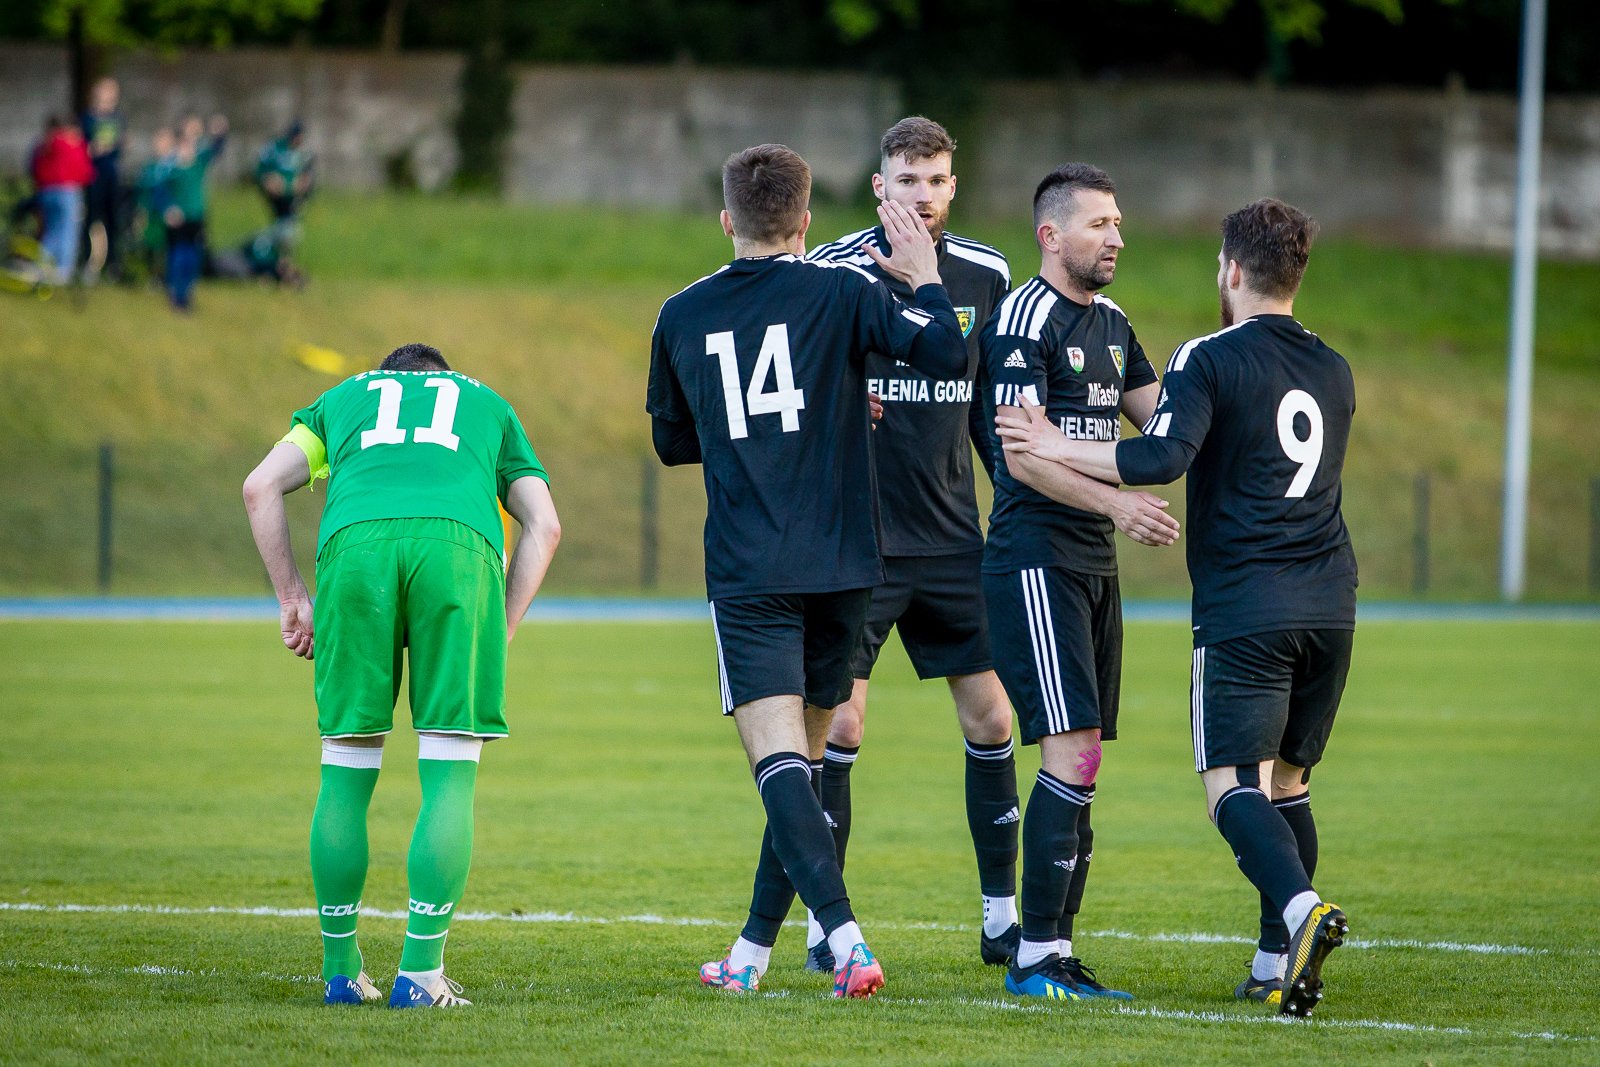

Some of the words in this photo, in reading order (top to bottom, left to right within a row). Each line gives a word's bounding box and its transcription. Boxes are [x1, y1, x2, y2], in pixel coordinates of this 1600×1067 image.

[705, 323, 805, 440] 14
[866, 378, 930, 402] ELENIA
[1087, 382, 1120, 407] Miasto
[360, 377, 460, 453] 11
[1276, 389, 1324, 498] 9
[408, 897, 454, 917] COLO
